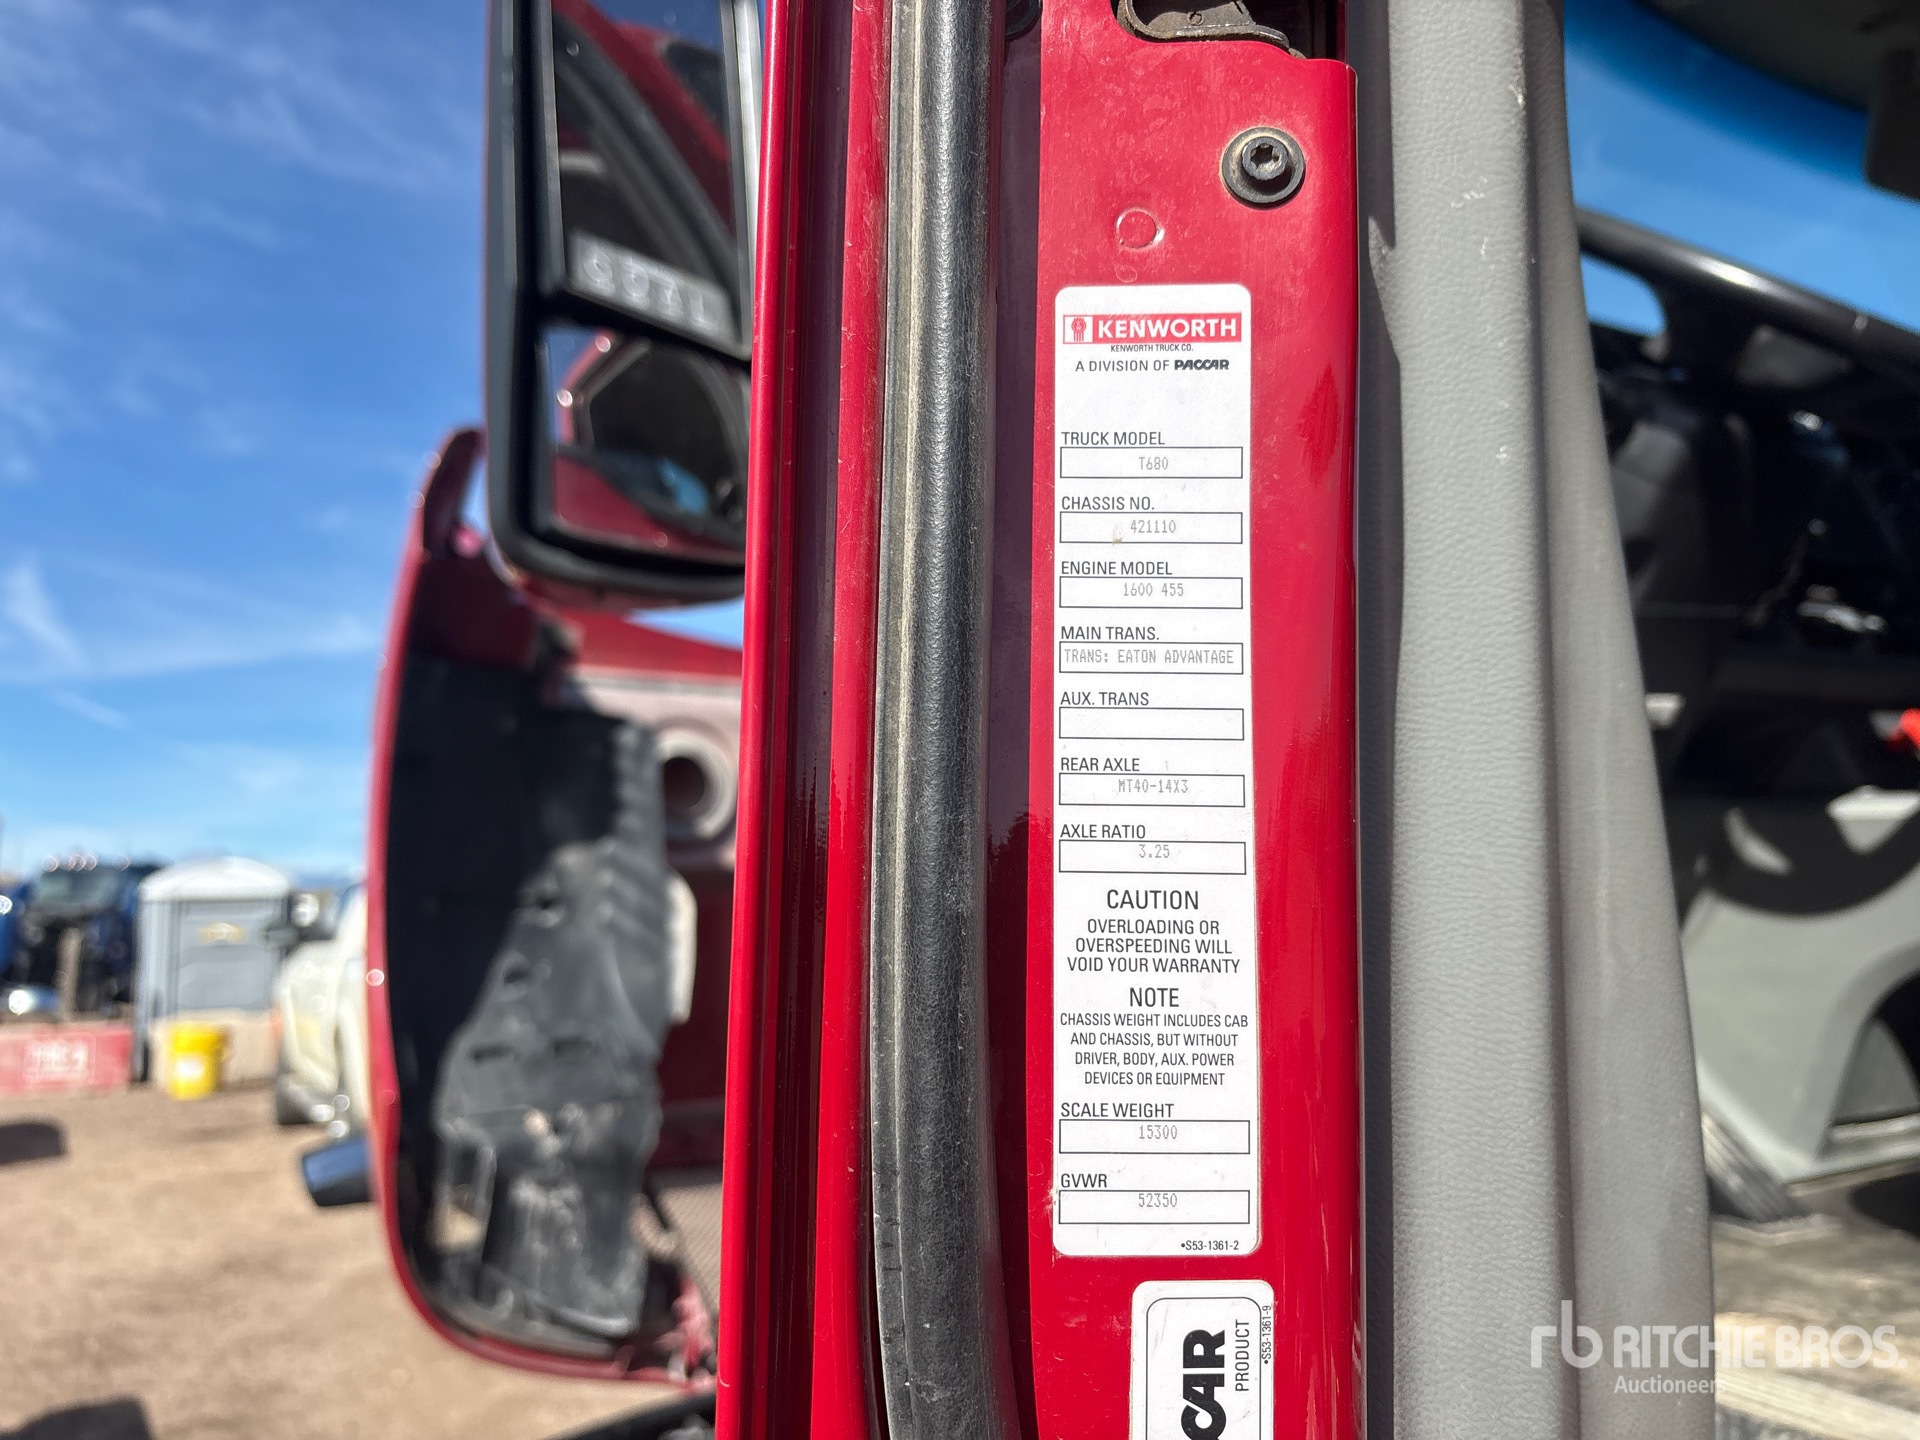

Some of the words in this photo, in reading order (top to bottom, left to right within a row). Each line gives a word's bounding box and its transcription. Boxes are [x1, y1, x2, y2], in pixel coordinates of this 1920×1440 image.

[1099, 318, 1236, 338] KENWORTH
[1075, 361, 1084, 372] A
[1089, 360, 1148, 371] DIVISION
[1153, 360, 1169, 371] OF
[1174, 359, 1229, 370] PACCAR
[1061, 432, 1109, 445] TRUCK
[1114, 432, 1165, 445] MODEL
[1139, 457, 1168, 470] T680
[1061, 497, 1125, 510] CHASSIS
[1130, 497, 1154, 510] NO.
[1130, 520, 1176, 533] 421110
[1061, 561, 1116, 574] ENGINE
[1121, 561, 1172, 575] MODEL
[1123, 583, 1153, 596] 1600
[1161, 583, 1184, 596] 455
[1061, 626, 1101, 640] MAIN
[1105, 627, 1159, 640] TRANS.
[1064, 649, 1108, 663] TRANS:
[1118, 650, 1156, 663] EATON
[1165, 650, 1233, 664] ADVANTAGE
[1061, 692, 1095, 705] AUX.
[1099, 692, 1149, 705] TRANS
[1061, 758, 1099, 771] REAR
[1103, 758, 1140, 771] AXLE
[1118, 779, 1188, 793] MT40-14X3
[1060, 824, 1097, 838] AXLE
[1102, 825, 1146, 838] RATIO
[1139, 844, 1170, 858] 3.25
[1107, 889, 1199, 909] CAUTION
[1088, 919, 1194, 934] OVERLOADING
[1200, 921, 1219, 934] OR
[1076, 938, 1190, 953] OVERSPEEDING
[1195, 940, 1232, 954] WILL
[1067, 957, 1103, 971] VOID
[1108, 958, 1148, 972] YOUR
[1153, 958, 1240, 973] WARRANTY
[1130, 988, 1179, 1007] NOTE
[1060, 1013, 1111, 1026] CHASSIS
[1114, 1014, 1160, 1026] WEIGHT
[1164, 1014, 1221, 1027] INCLUDES
[1225, 1015, 1248, 1027] CAB
[1071, 1033, 1096, 1045] AND
[1100, 1033, 1153, 1047] CHASSIS,
[1158, 1034, 1180, 1046] BUT
[1183, 1034, 1238, 1046] WITHOUT
[1075, 1052, 1119, 1067] DRIVER,
[1124, 1053, 1157, 1067] BODY,
[1161, 1053, 1188, 1065] AUX.
[1192, 1054, 1234, 1066] POWER
[1085, 1072, 1133, 1084] DEVICES
[1137, 1073, 1152, 1084] OR
[1156, 1073, 1225, 1085] EQUIPMENT
[1061, 1103, 1108, 1117] SCALE
[1113, 1103, 1174, 1117] WEIGHT
[1139, 1125, 1177, 1139] 15300
[1061, 1174, 1107, 1188] GVWR
[1138, 1193, 1177, 1208] 52350
[1235, 1319, 1249, 1391] PRODUCT
